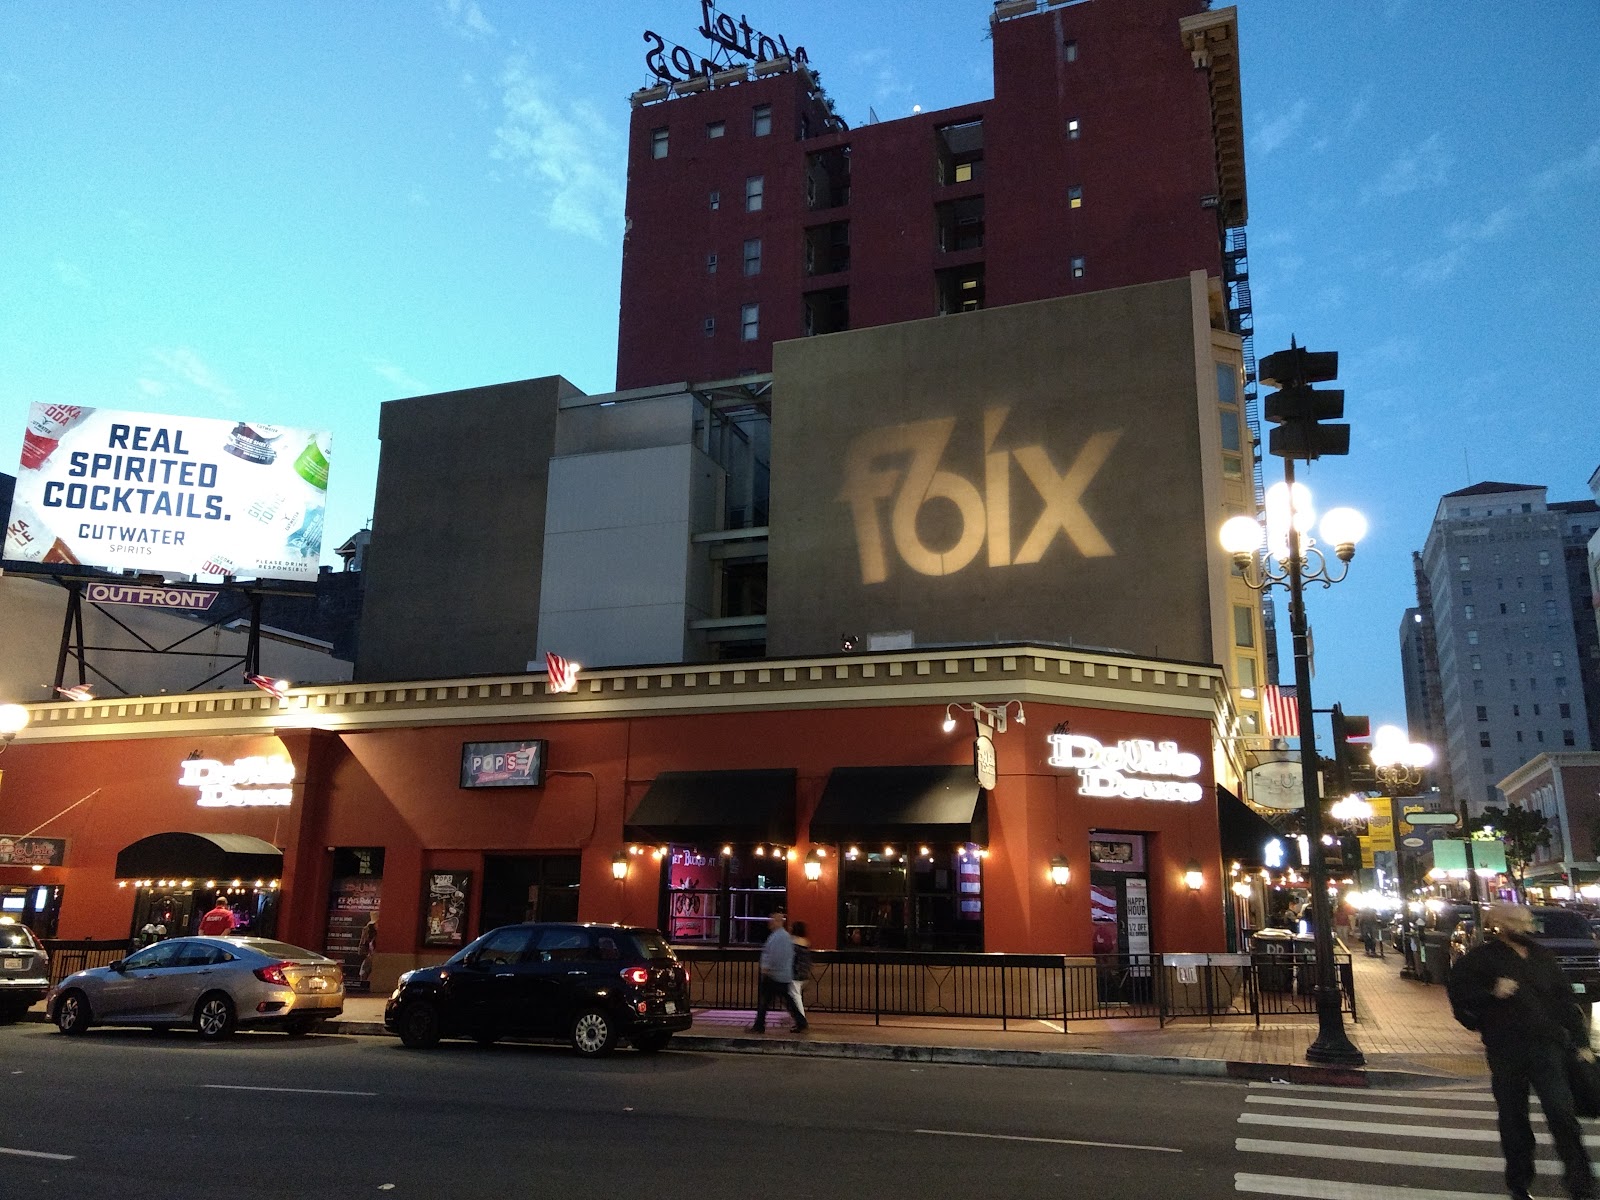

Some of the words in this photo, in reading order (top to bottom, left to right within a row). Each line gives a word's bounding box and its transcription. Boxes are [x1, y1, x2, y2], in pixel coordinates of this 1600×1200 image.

[108, 424, 189, 455] REAL
[68, 451, 218, 488] SPIRITED
[43, 481, 231, 521] COCKTAILS.
[78, 523, 186, 546] CUTWATER
[109, 544, 152, 555] SPIRITS
[258, 564, 308, 573] RESPONSIBLY
[91, 584, 210, 607] OUTFRONT
[1127, 897, 1146, 906] HAPPY
[1128, 905, 1147, 916] HOUR
